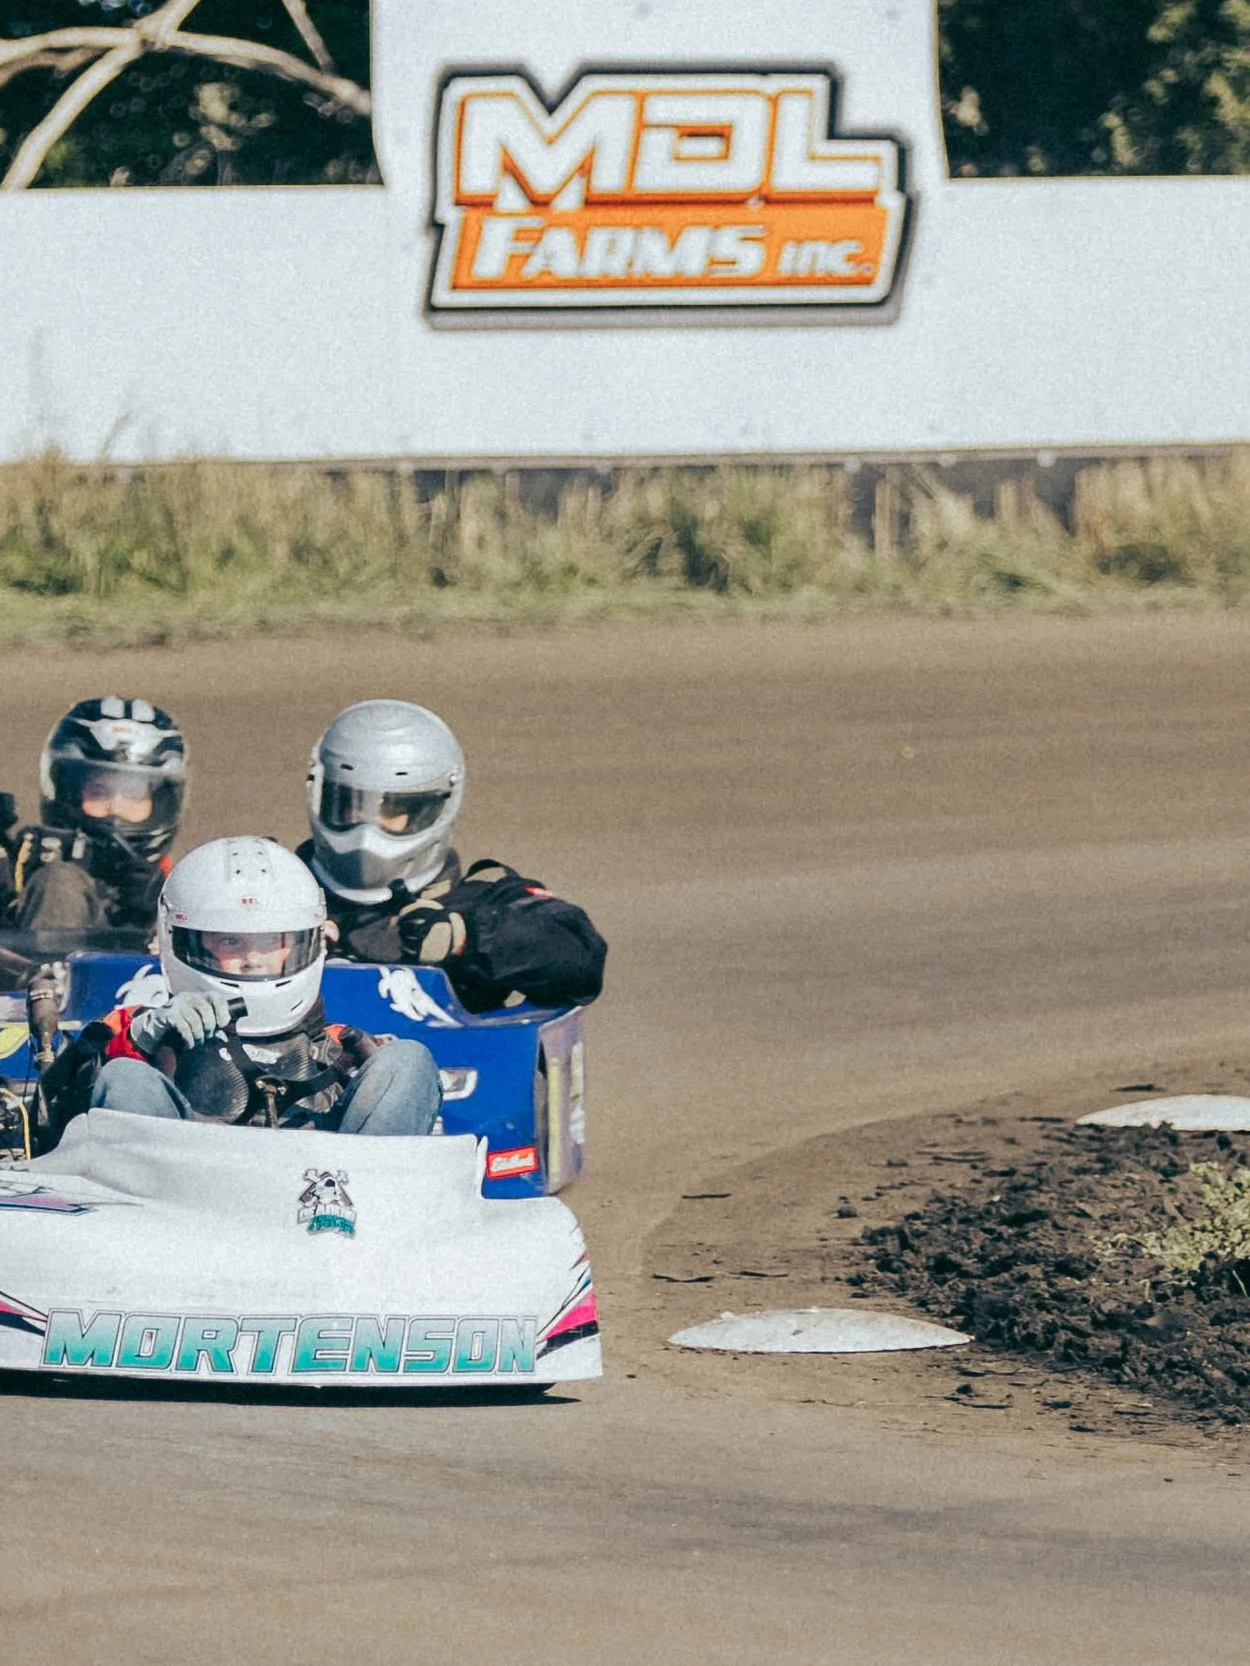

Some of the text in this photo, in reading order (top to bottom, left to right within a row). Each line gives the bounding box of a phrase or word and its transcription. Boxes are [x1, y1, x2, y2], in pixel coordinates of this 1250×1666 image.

[456, 91, 881, 196] MDL
[472, 217, 767, 277] FARMS
[44, 1308, 540, 1375] MORTENSON
